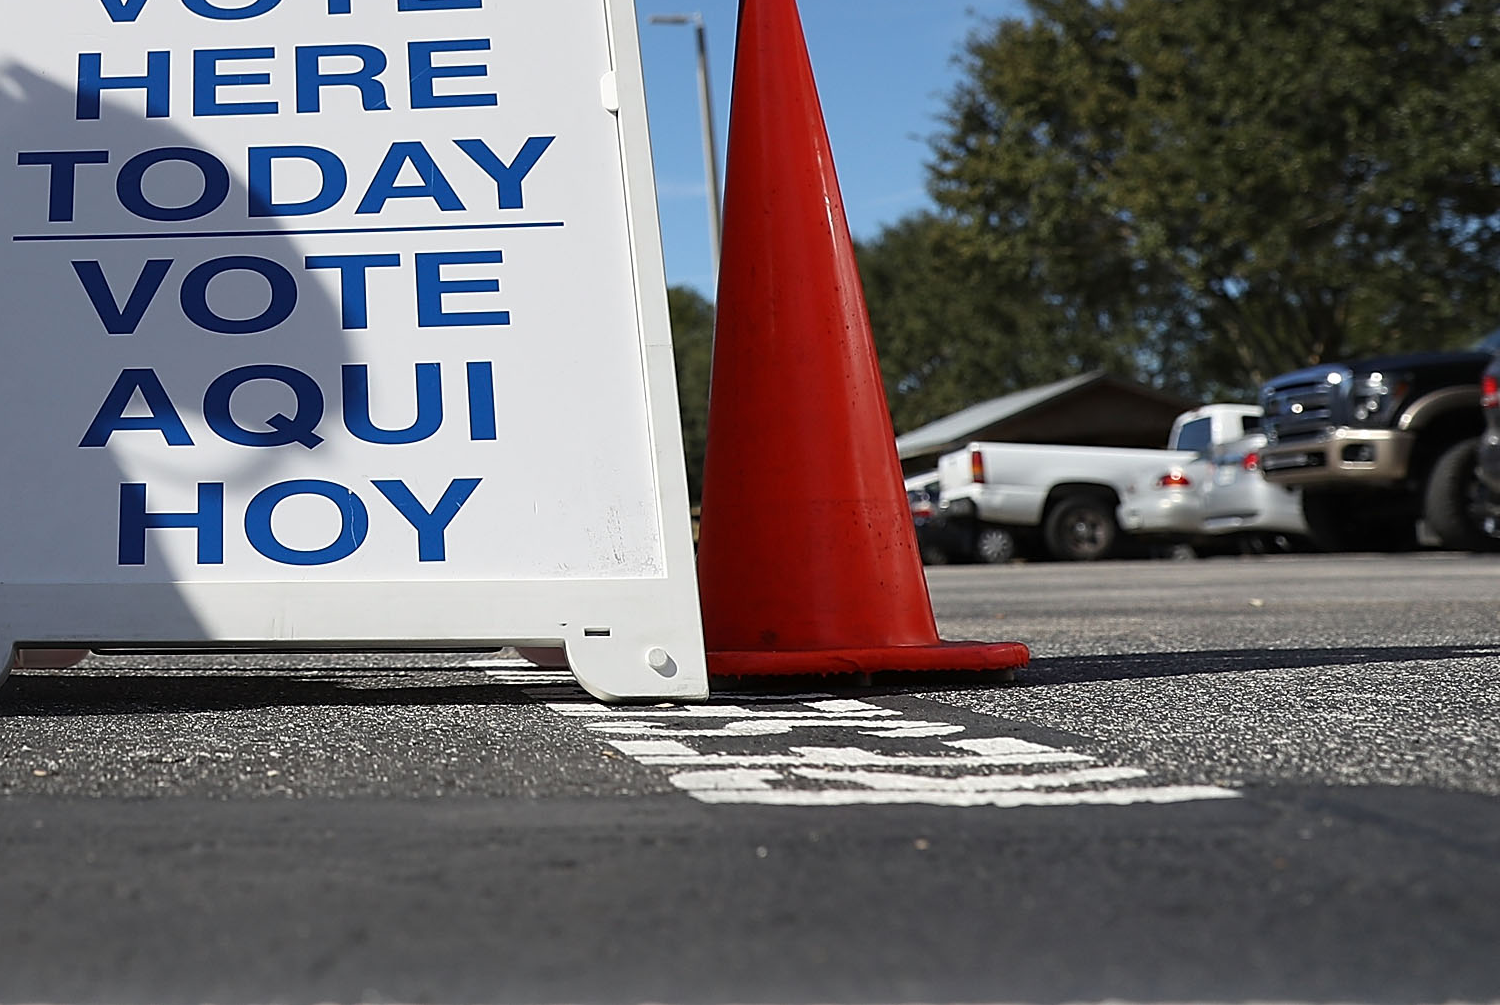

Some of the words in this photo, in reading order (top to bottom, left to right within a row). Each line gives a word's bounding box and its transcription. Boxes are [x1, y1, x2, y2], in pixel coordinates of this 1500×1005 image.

[75, 38, 499, 121] HERE
[17, 135, 557, 223] TODAY
[71, 250, 511, 336] VOTE
[78, 361, 498, 450] AQUI
[117, 477, 484, 566] HOY
